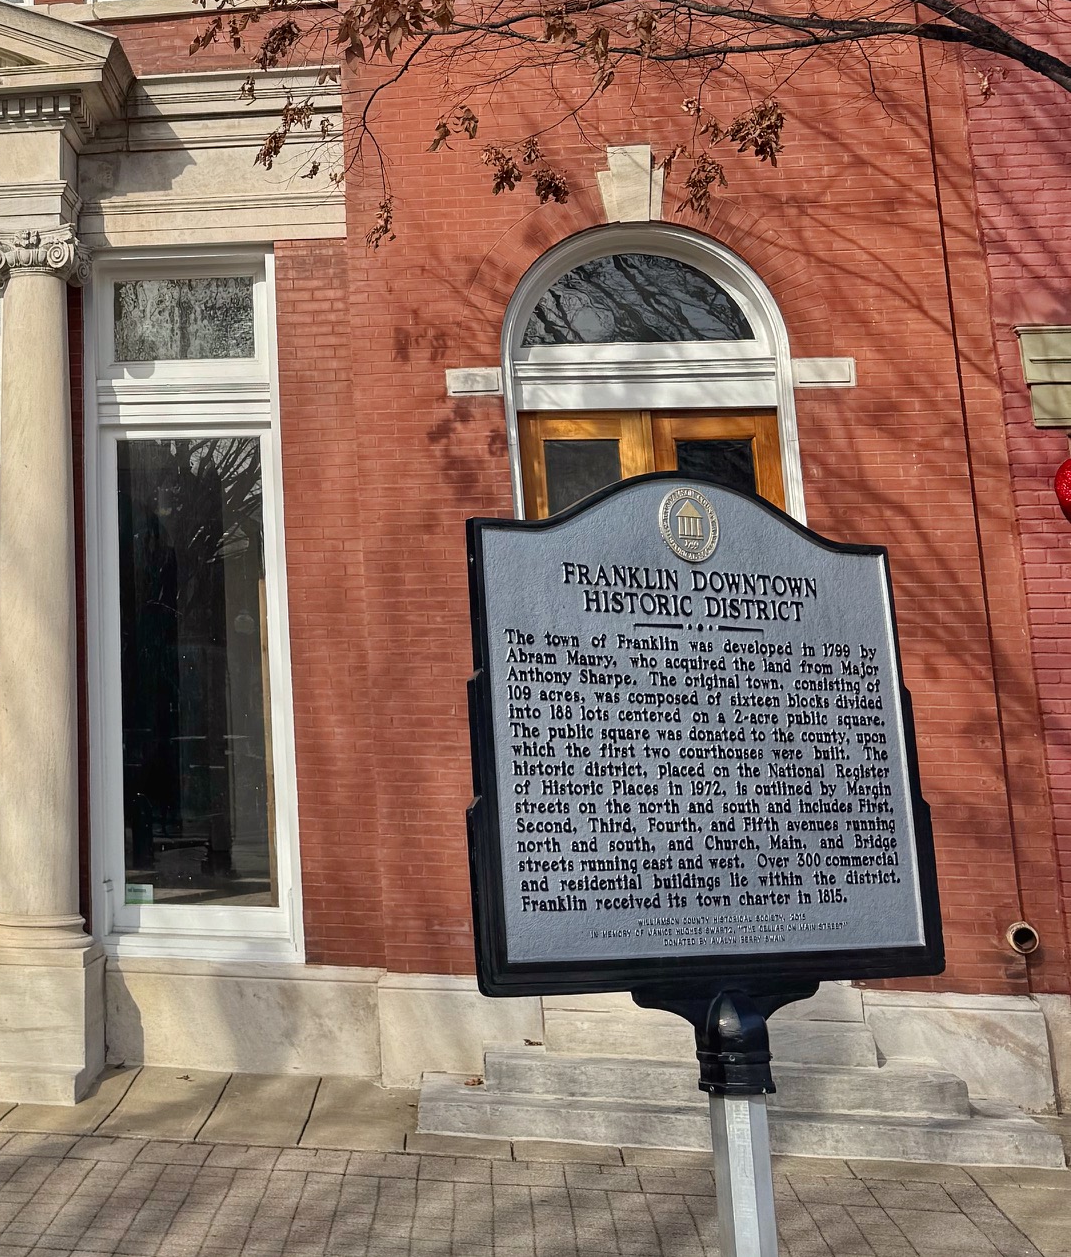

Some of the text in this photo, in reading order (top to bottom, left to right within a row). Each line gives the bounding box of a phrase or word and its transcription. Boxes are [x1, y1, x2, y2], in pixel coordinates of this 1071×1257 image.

[561, 561, 817, 599] FRANKLIN DOWNTOWN
[583, 589, 804, 622] HISTORIC DISTRICT
[503, 628, 876, 662] The town of Franklin was developed in 1799 by
[506, 647, 879, 680] Abram Maury, who acquired the land from Major
[506, 666, 572, 686] Anthony
[579, 668, 637, 688] Sharpe.
[648, 671, 676, 687] The
[684, 672, 739, 691] original
[794, 676, 860, 695] consisting
[866, 678, 880, 693] of
[507, 684, 883, 710] 109 acres, was composed of sixteen blocks divided
[509, 703, 885, 730] into 188 lots centered on a 2-acre public square.
[509, 722, 886, 746] The public square was donated to the county, upon
[510, 741, 888, 762] which the first two courthouses were built. The
[512, 760, 889, 781] historic district, placed on the National Register
[514, 779, 891, 798] of Historic Places in 1972, is outlined by Margin
[515, 798, 894, 814] streets on the north and south and includes First,
[516, 816, 895, 834] Second, Third, Fourth, and Fifth avenues running
[517, 833, 897, 853] north and south, and Church, Main, and Bridge
[518, 851, 899, 874] streets running east and west. Over 300 commercial
[521, 869, 900, 892] and residential buildings lie within the district.
[521, 888, 847, 912] Franklin received its town charter in 1815.
[683, 916, 709, 925] COUNTY
[663, 938, 695, 946] DONATED
